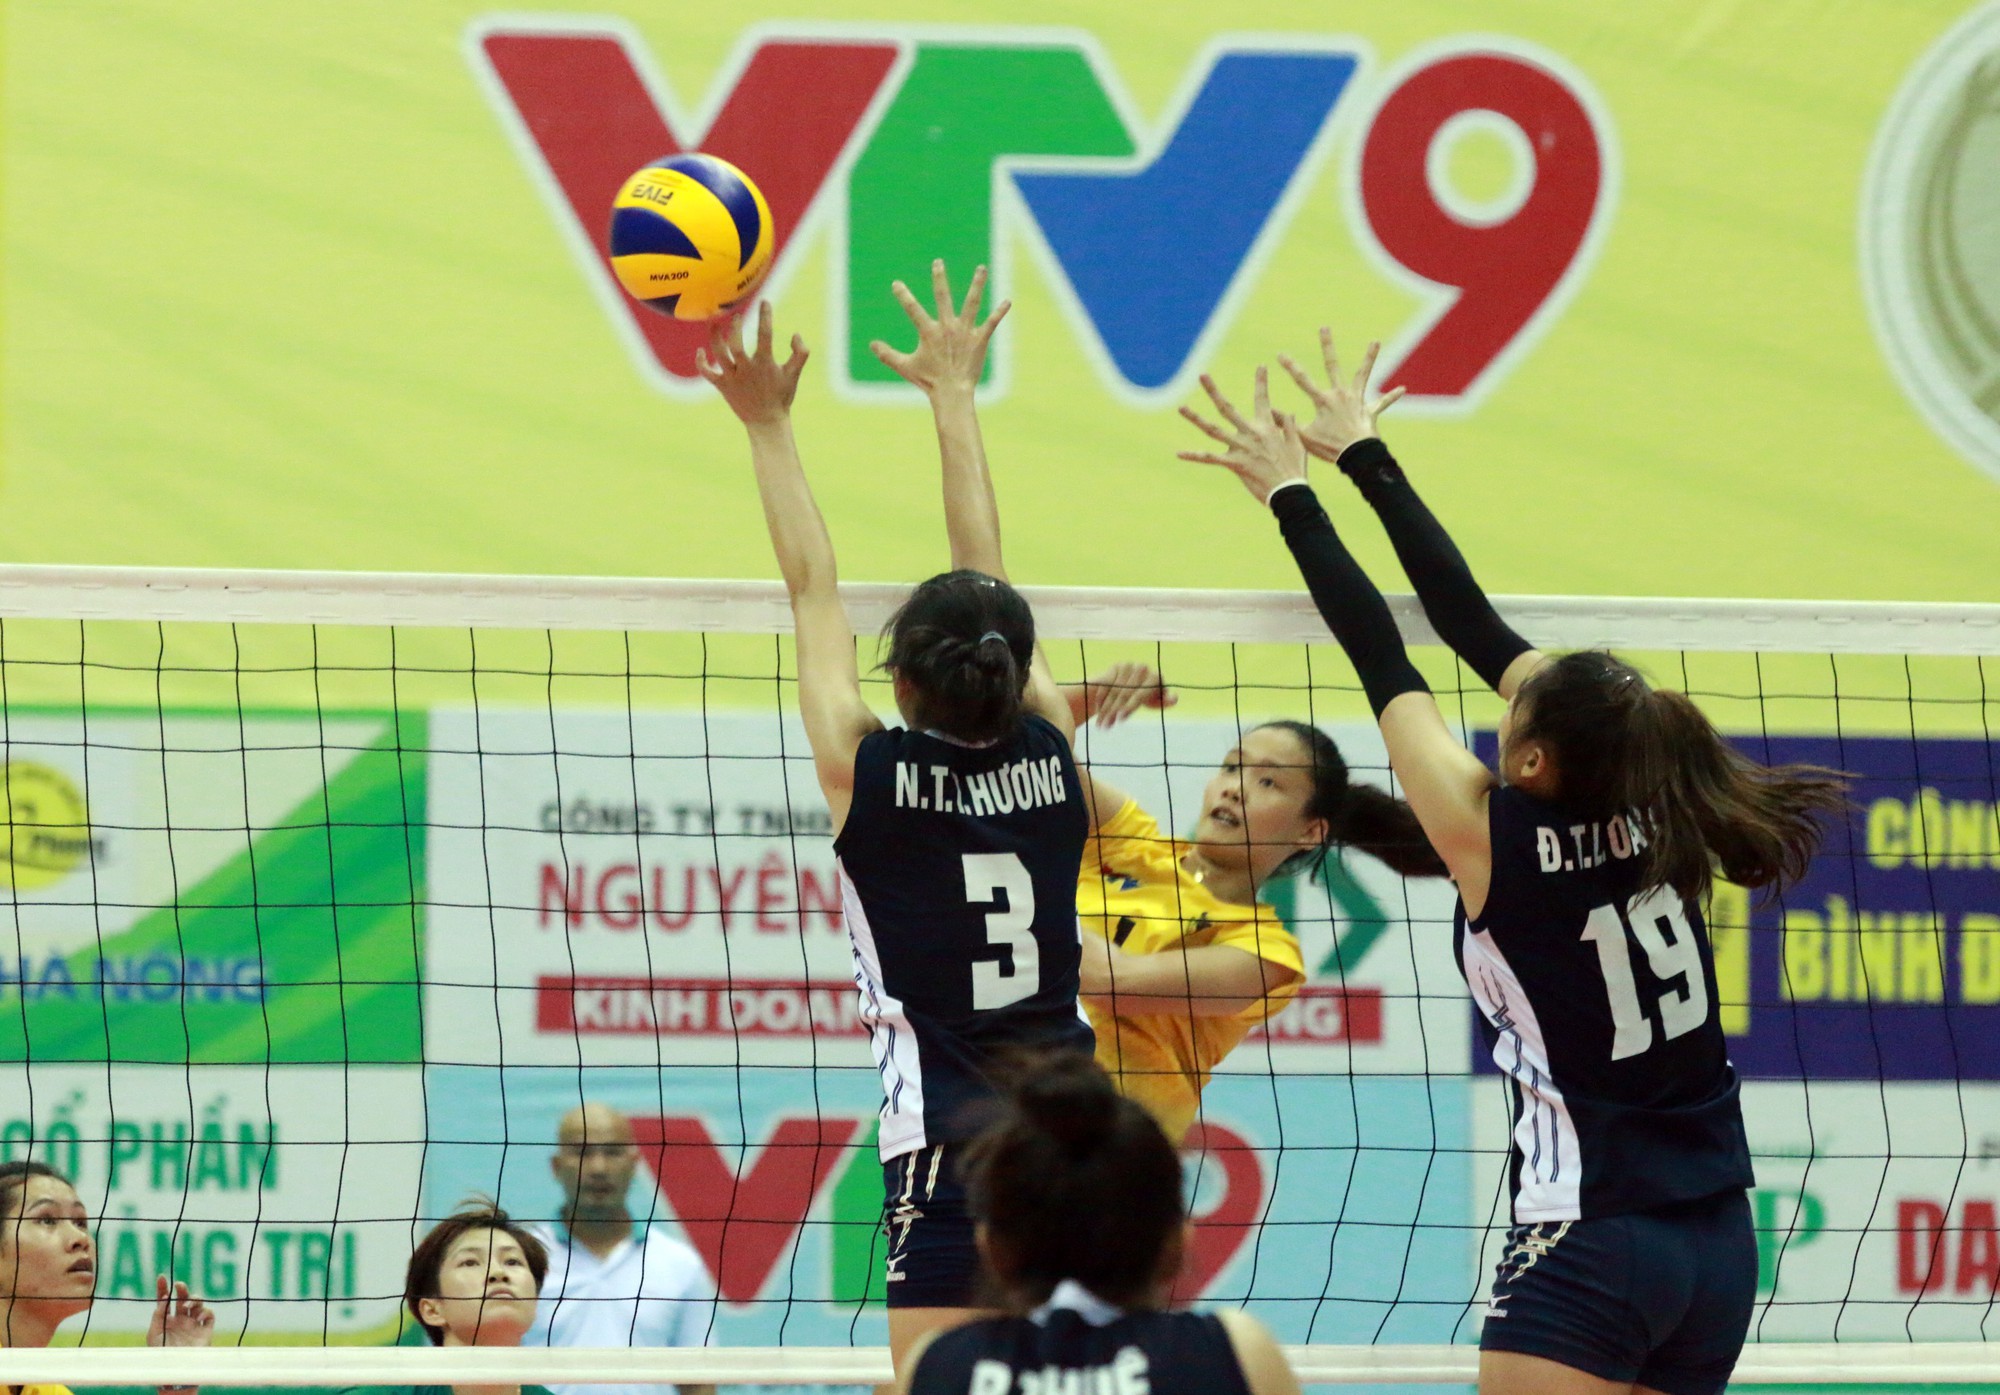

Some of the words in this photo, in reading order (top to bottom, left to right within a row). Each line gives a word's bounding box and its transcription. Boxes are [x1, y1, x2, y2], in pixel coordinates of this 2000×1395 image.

[479, 30, 1602, 398] VTV9
[649, 271, 690, 282] MVA200
[671, 805, 719, 835] TY
[1535, 804, 1658, 873] Đ.T.LOA
[1866, 786, 2000, 871] CÔN
[961, 852, 1040, 1011] 3
[1579, 881, 1709, 1062] 19
[1780, 894, 1946, 1004] BÌNH
[91, 949, 269, 1003] NÔNG
[574, 984, 708, 1031] KINH
[96, 1204, 238, 1299] ẢNG
[260, 1229, 358, 1319] TRỊ
